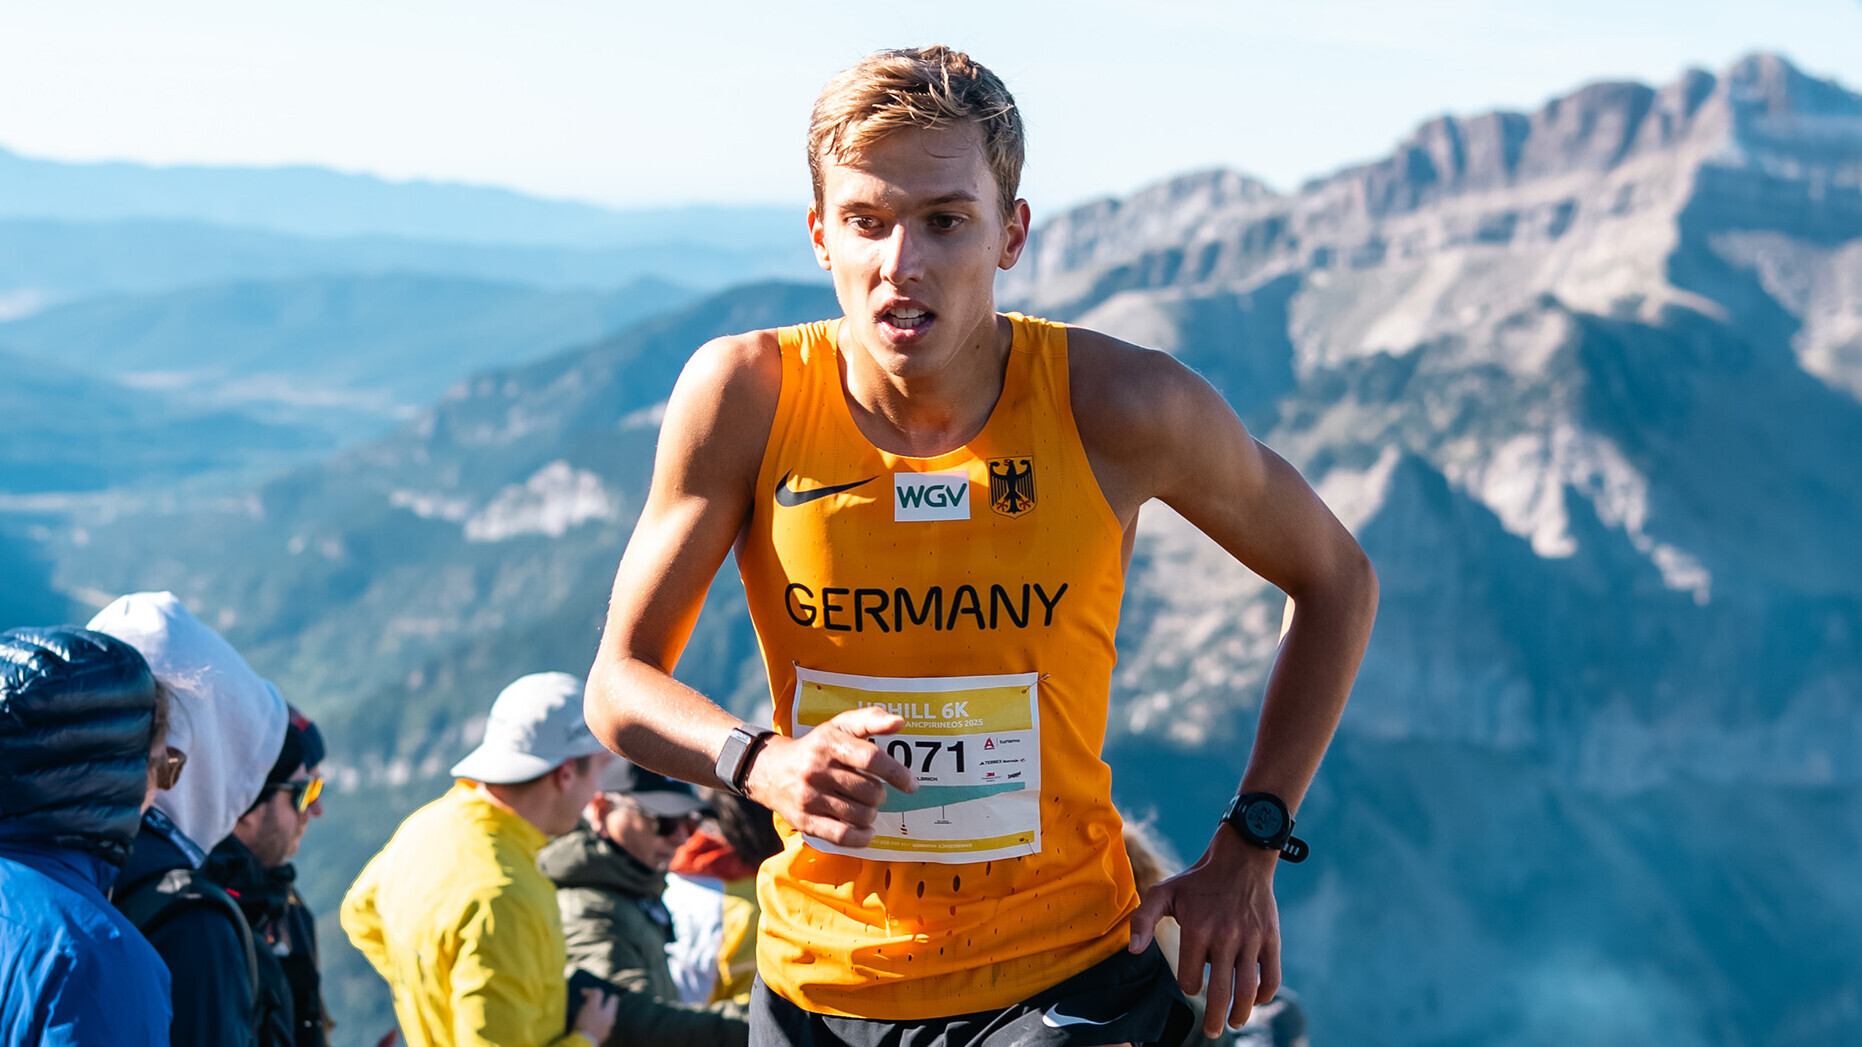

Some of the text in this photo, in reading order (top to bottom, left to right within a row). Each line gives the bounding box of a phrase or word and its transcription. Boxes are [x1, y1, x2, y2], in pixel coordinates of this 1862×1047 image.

[896, 482, 968, 509] WGV
[784, 582, 1069, 633] GERMANY
[905, 718, 984, 729] ANCPIRINEOS 2025
[941, 701, 969, 719] 6K
[867, 737, 966, 774] 071
